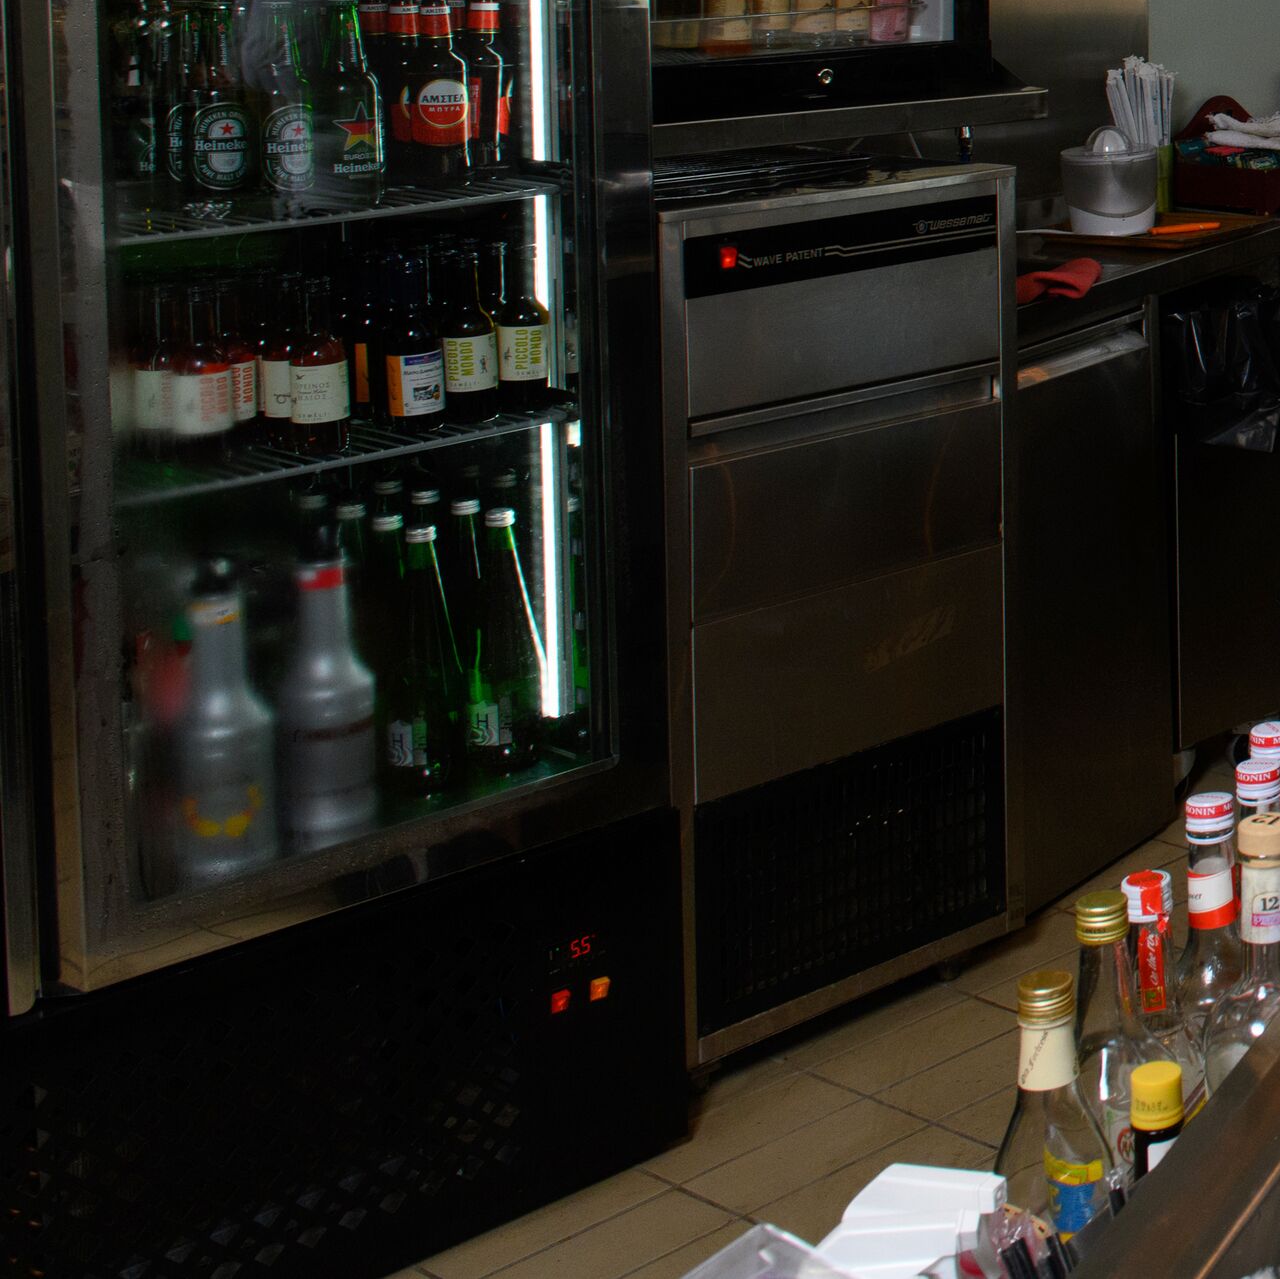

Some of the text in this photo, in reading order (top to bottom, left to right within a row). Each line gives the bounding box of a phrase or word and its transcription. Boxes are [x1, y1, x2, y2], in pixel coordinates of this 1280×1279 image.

[421, 94, 465, 104] ΑΜΣΤΕΛ
[195, 140, 247, 151] Heineke
[929, 212, 993, 231] wessamat
[753, 246, 823, 268] WAVE PATENT
[515, 329, 528, 371] PICCOLO
[529, 329, 542, 365] MONDO
[447, 340, 460, 382] PICCOLO
[460, 341, 473, 377] MONDO
[1236, 770, 1272, 783] MONIN
[1260, 896, 1280, 912] 12
